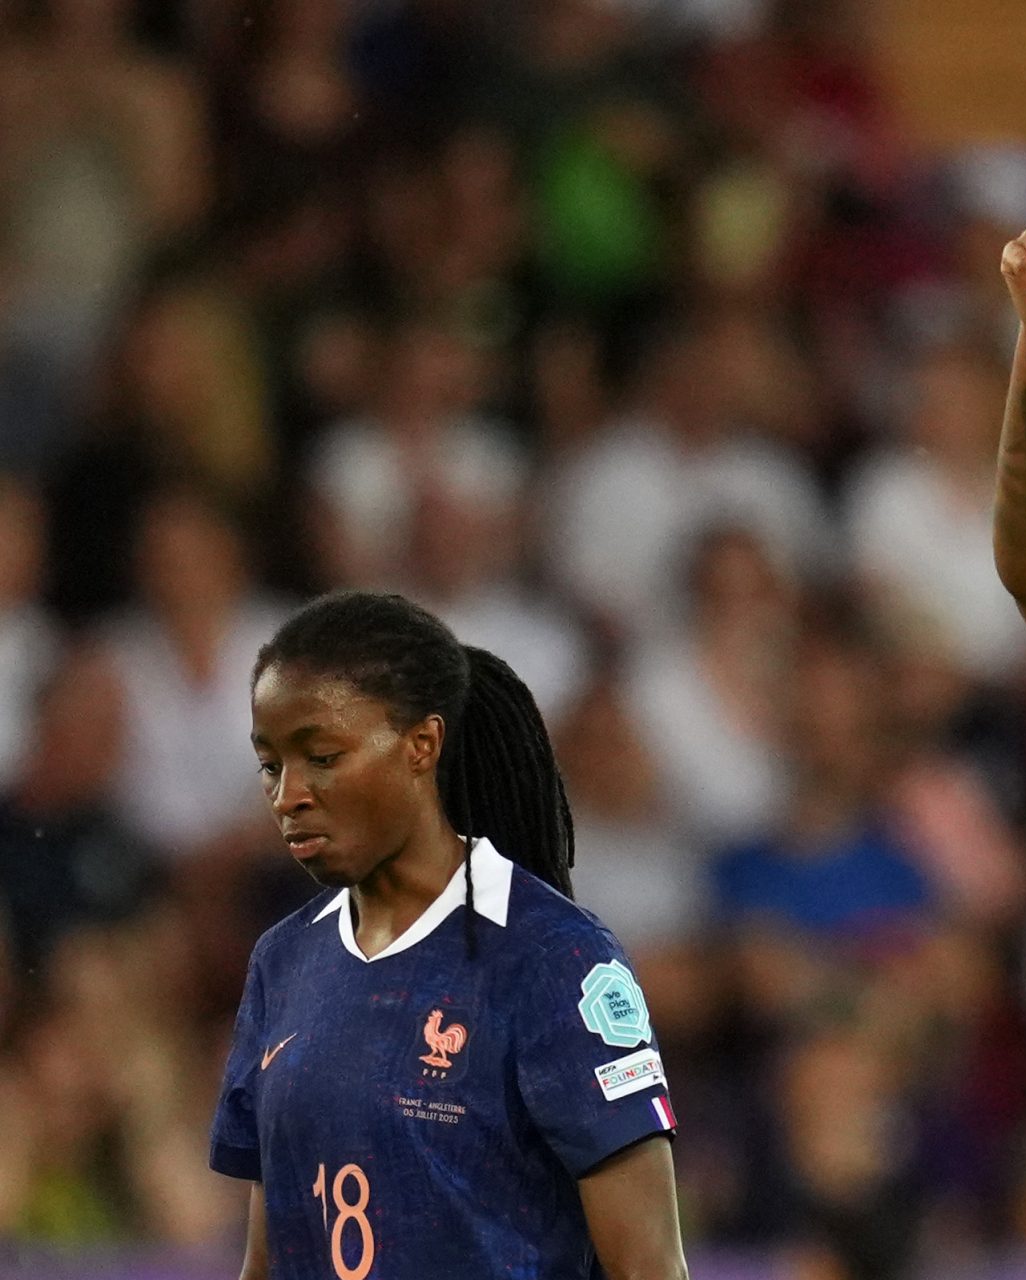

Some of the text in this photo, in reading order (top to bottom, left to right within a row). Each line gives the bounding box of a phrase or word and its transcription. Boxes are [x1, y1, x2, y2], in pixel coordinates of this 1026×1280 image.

[598, 1064, 617, 1076] UEFA
[399, 1097, 422, 1107] FRANCE
[428, 1102, 466, 1114] ANGLETERRE
[403, 1108, 459, 1124] 05 JUILLET 2025
